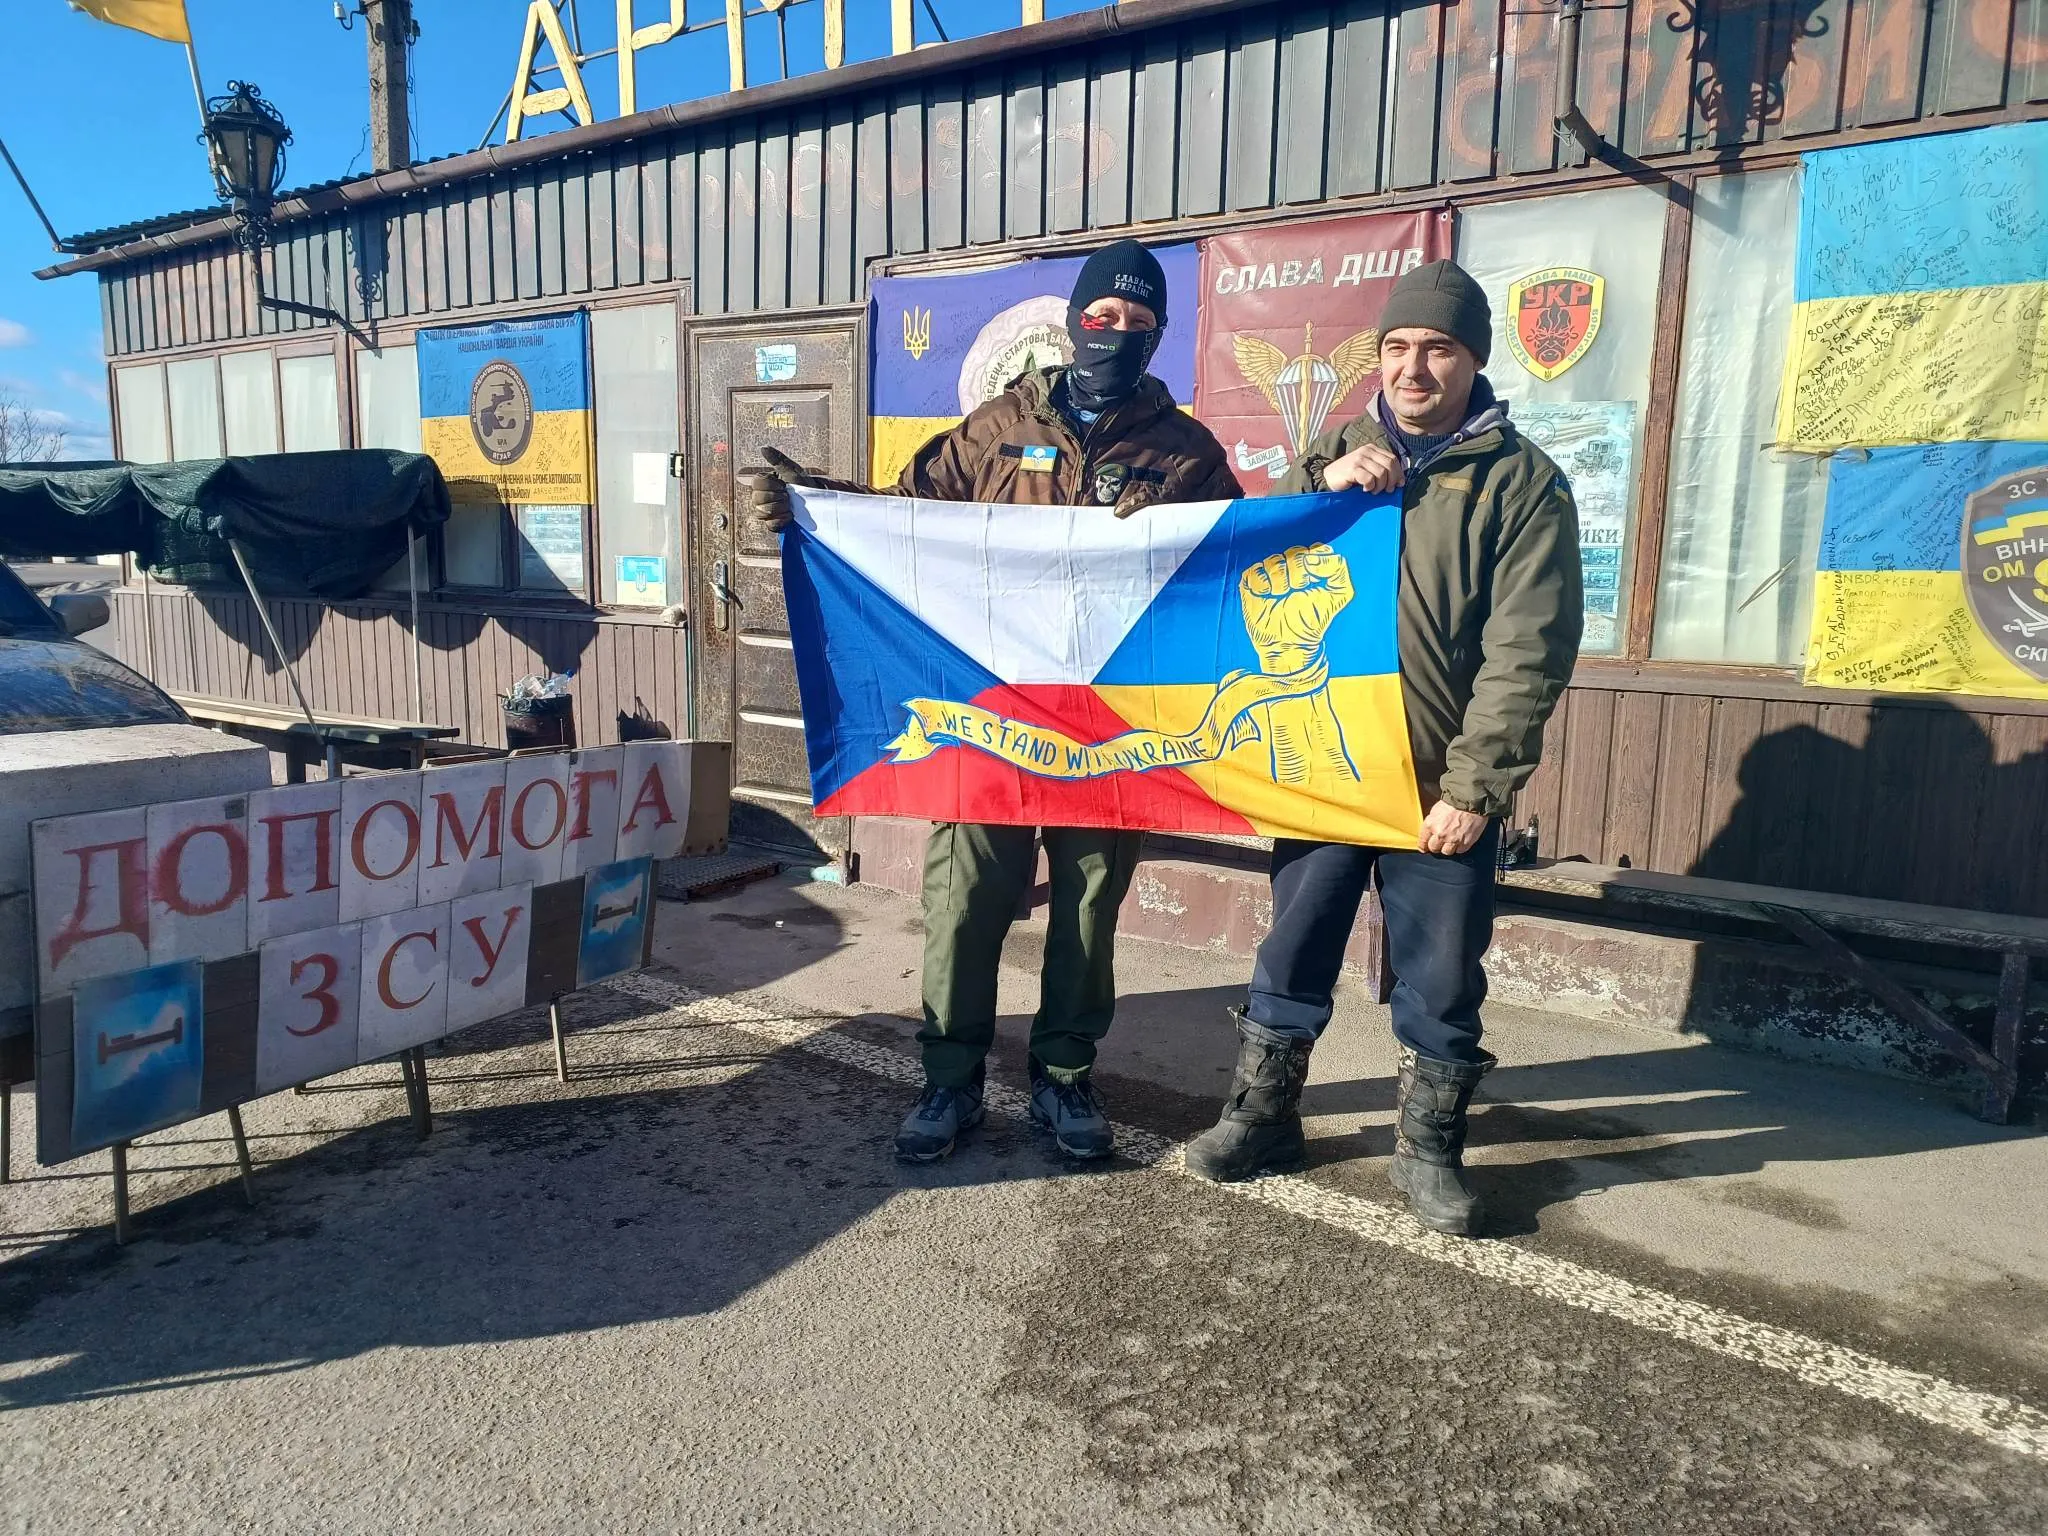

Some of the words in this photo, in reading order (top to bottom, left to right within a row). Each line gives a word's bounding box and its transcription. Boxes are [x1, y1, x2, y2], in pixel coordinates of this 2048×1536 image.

[1115, 273, 1144, 288] СЛАВА
[1215, 257, 1324, 294] СЛАВА
[1333, 247, 1424, 288] ДШВ
[1520, 271, 1558, 289] СЛАВА
[1525, 283, 1590, 308] УКР
[1508, 315, 1529, 365] СМЕРТЬ
[987, 361, 1006, 400] ВЕДЕНА
[1247, 446, 1280, 468] ЗАВЖДИ
[2008, 480, 2037, 499] ЗС
[1580, 528, 1620, 544] ИКИ
[1983, 559, 2026, 583] ОМ
[942, 711, 973, 738] WE
[983, 722, 1057, 767] STAND
[50, 763, 678, 970] ДОПОМОГА
[286, 906, 524, 1038] ЗСУ
